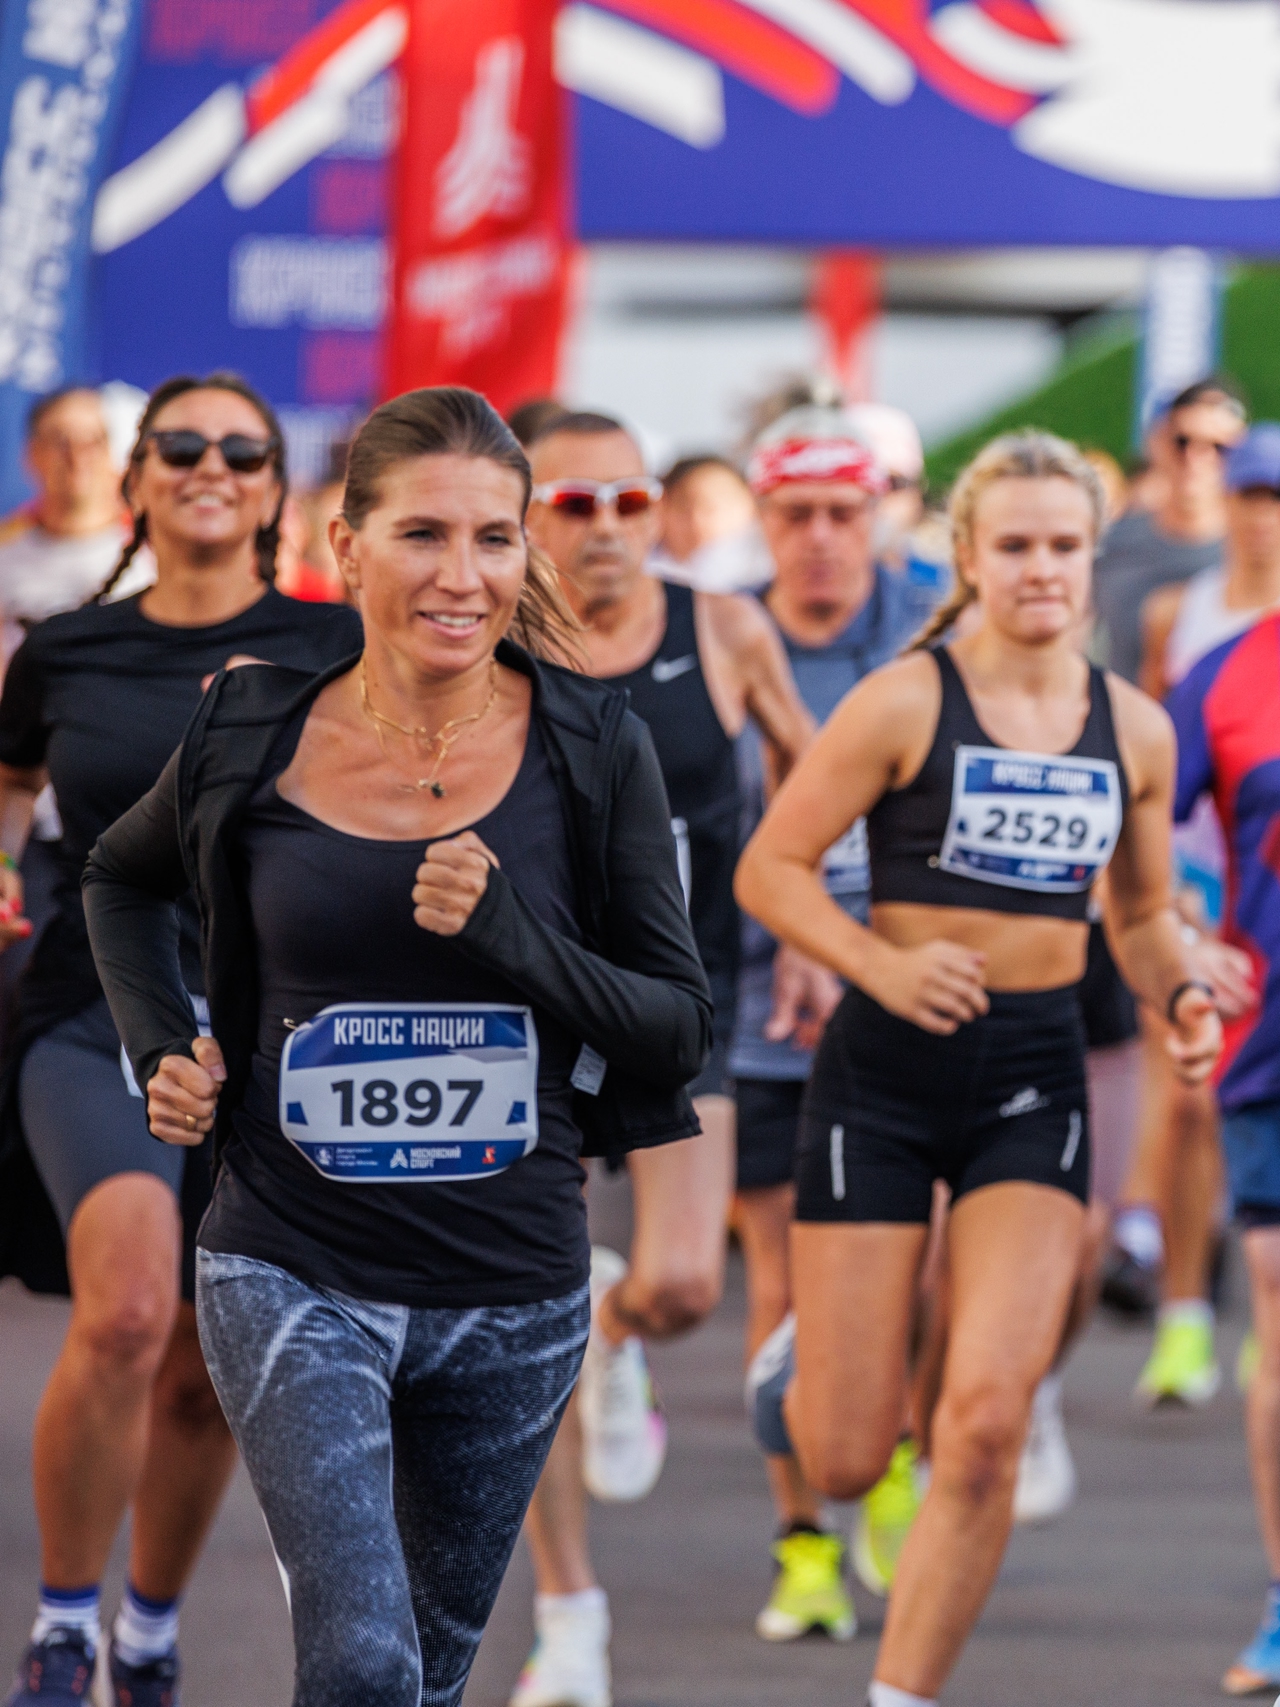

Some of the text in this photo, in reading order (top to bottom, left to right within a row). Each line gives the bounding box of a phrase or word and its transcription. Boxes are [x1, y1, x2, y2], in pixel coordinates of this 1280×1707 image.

[982, 808, 1088, 849] 2529
[334, 1017, 485, 1047] КРОСС НАЦИИ
[330, 1079, 484, 1127] 1897
